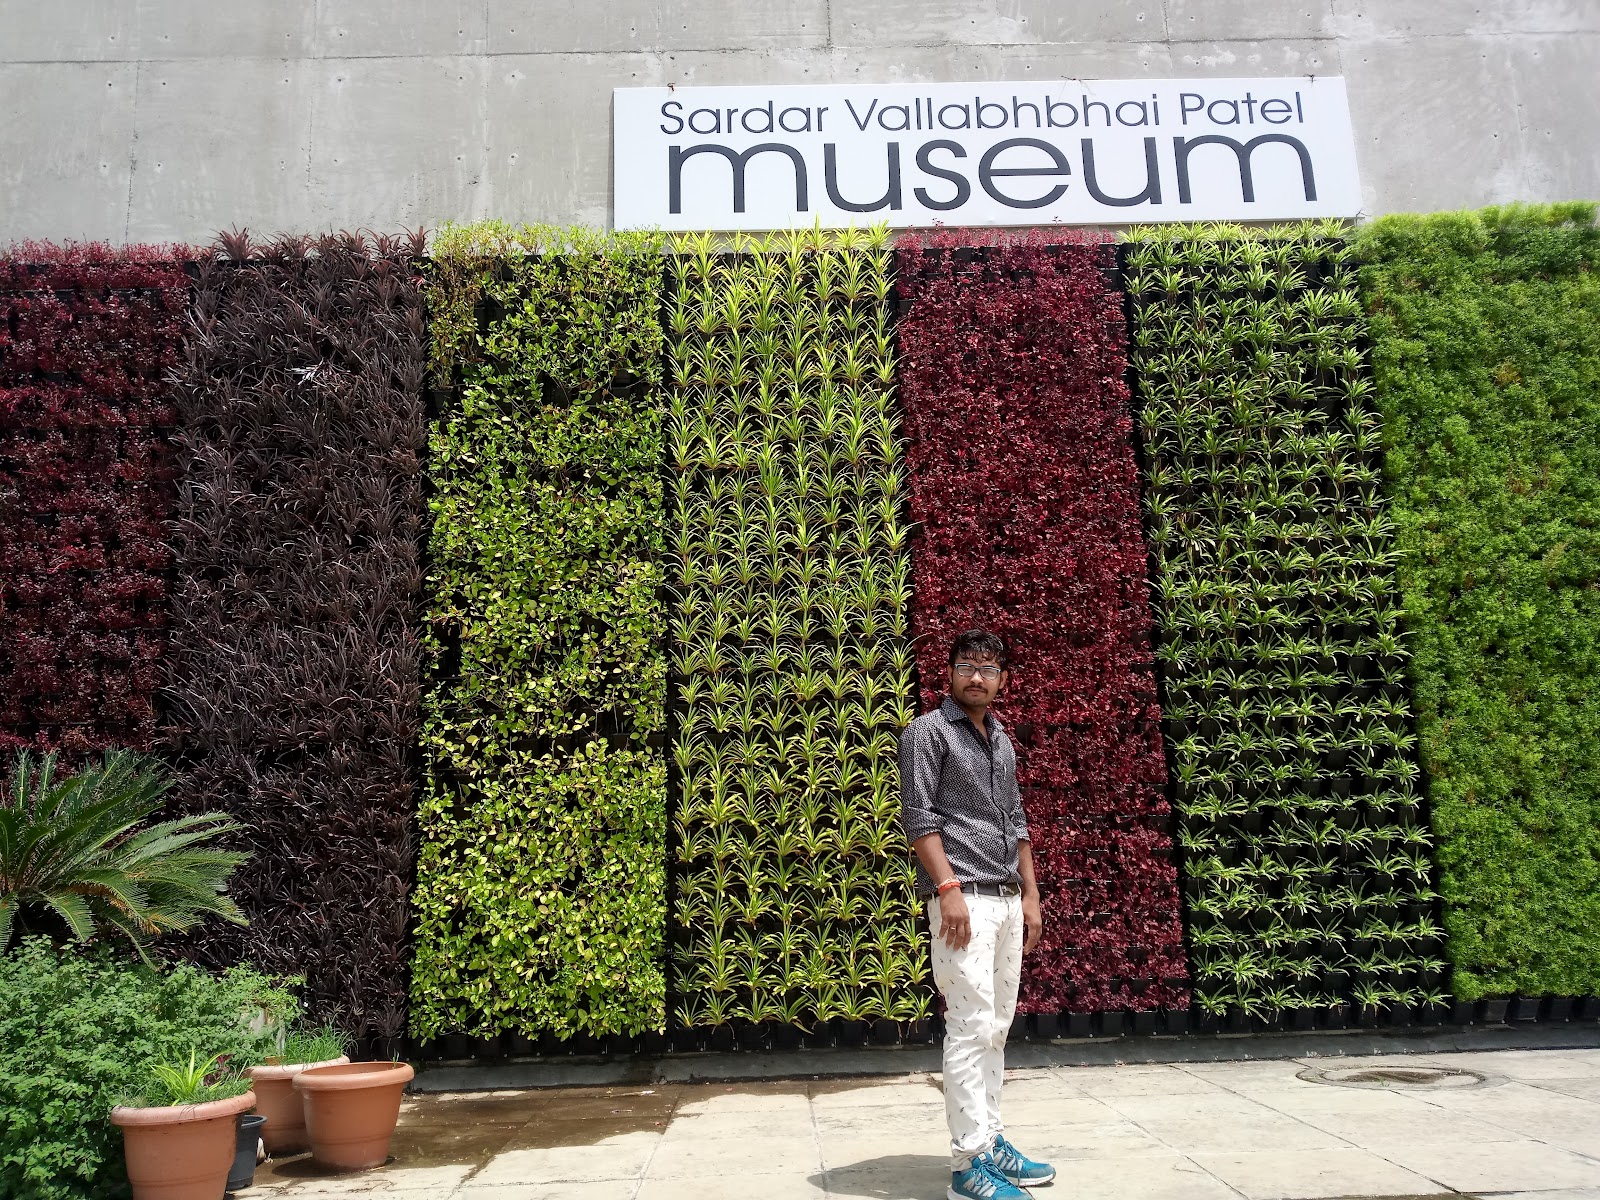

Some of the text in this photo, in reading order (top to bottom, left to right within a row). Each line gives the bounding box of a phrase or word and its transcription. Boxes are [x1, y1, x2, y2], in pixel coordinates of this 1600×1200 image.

[661, 91, 1304, 134] Sardar Vallabhbhai Patel
[668, 134, 1318, 215] museum
